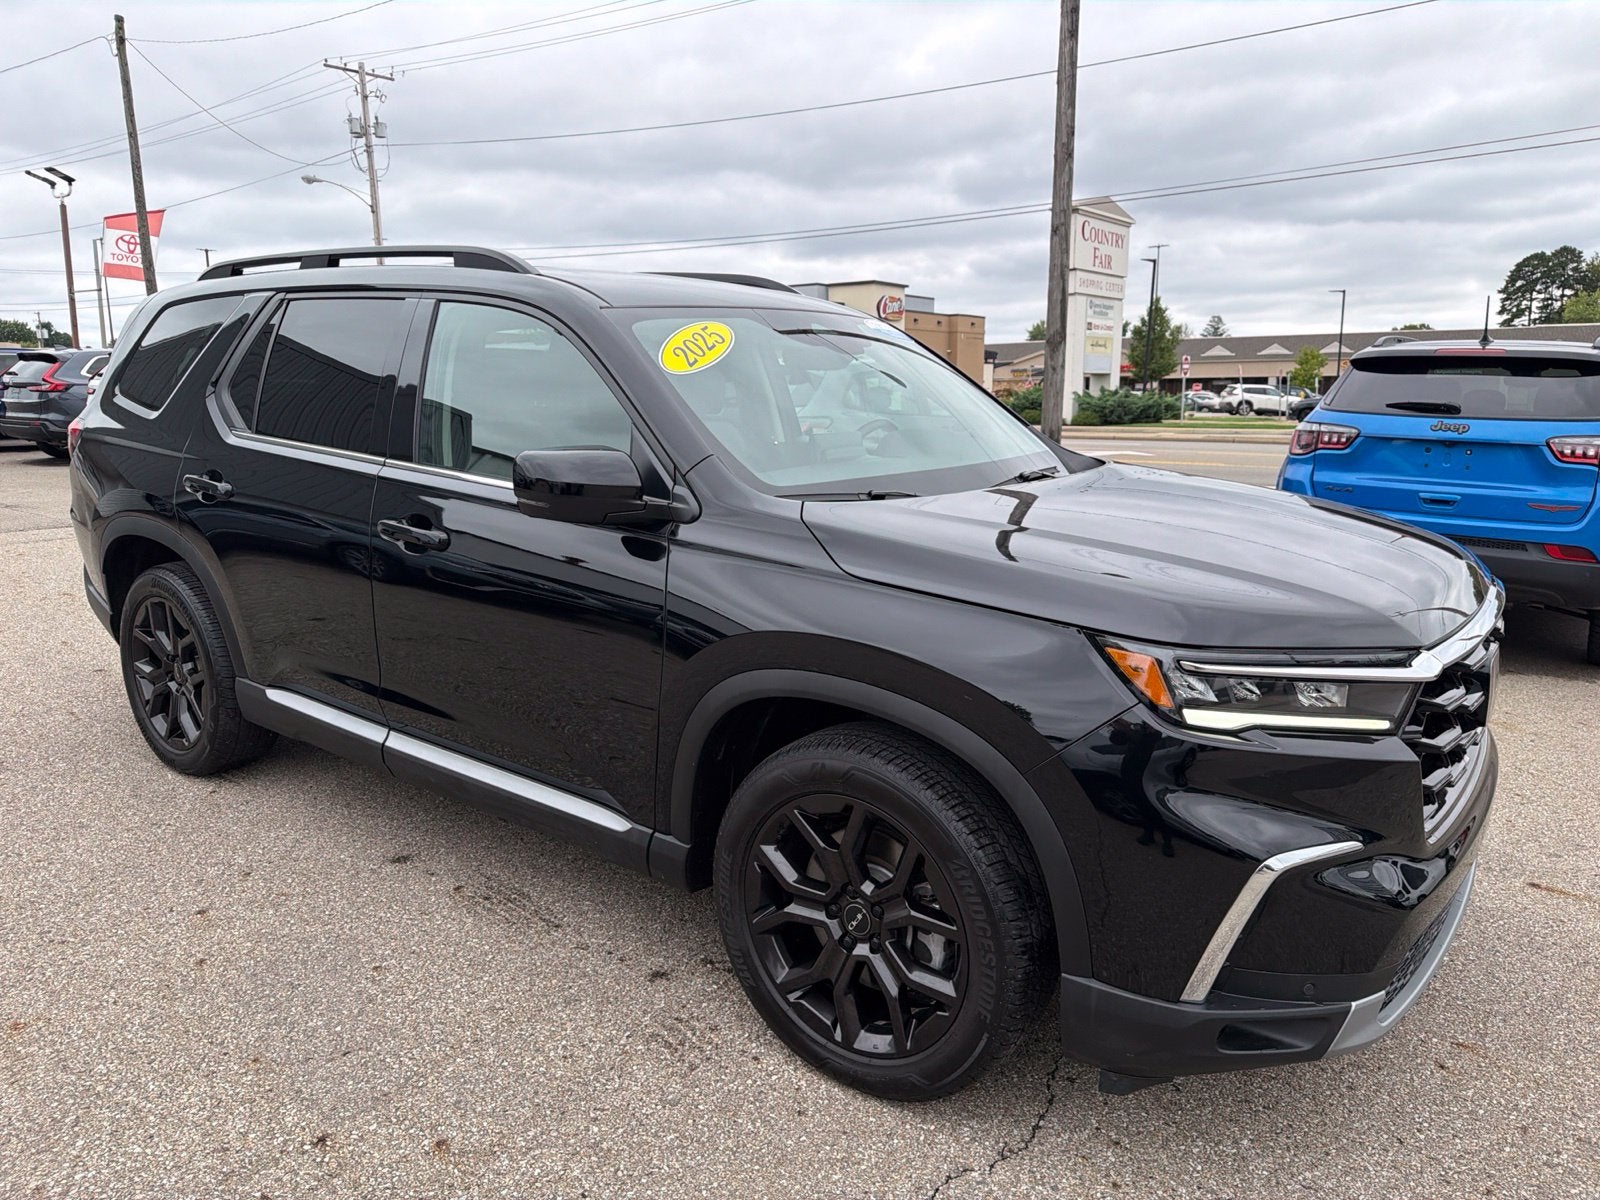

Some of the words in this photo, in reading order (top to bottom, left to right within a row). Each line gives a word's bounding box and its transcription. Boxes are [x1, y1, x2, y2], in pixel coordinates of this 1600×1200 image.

[1081, 219, 1125, 249] COUNTRY
[111, 252, 142, 264] TOYO
[1092, 246, 1112, 270] FAIR
[1105, 281, 1123, 293] CENTER
[672, 325, 726, 368] 2025
[1430, 420, 1470, 435] Jeep
